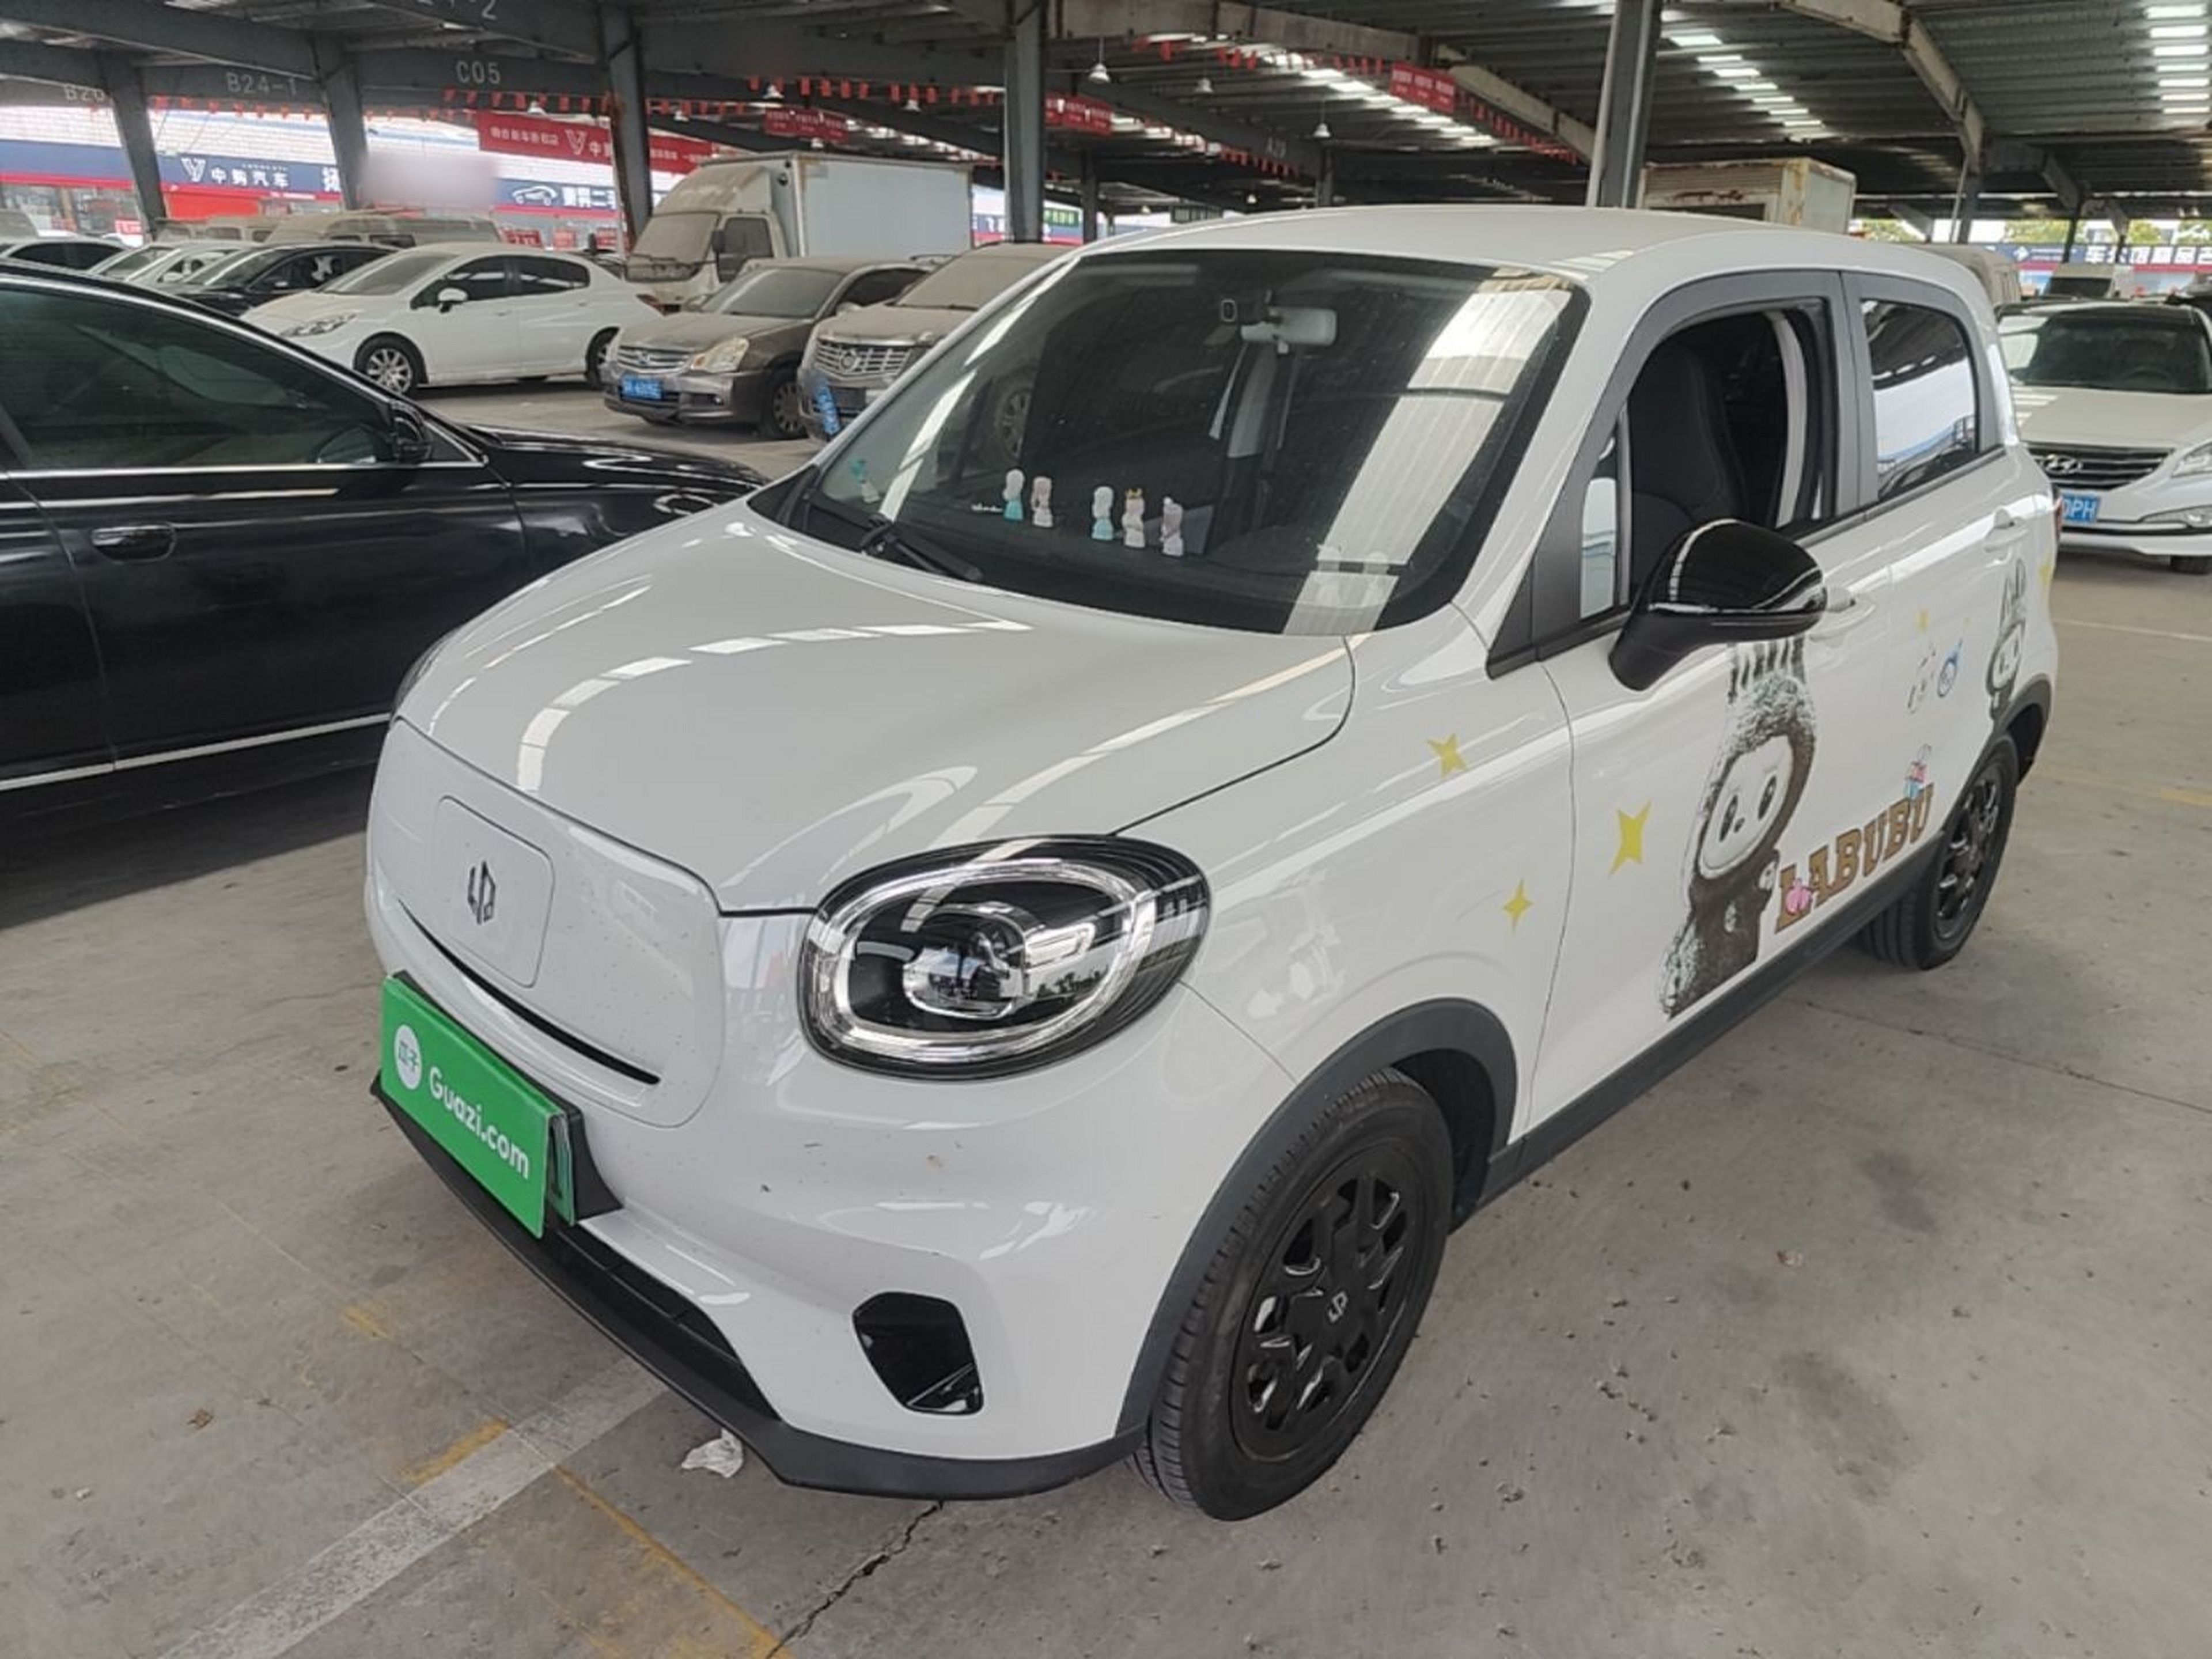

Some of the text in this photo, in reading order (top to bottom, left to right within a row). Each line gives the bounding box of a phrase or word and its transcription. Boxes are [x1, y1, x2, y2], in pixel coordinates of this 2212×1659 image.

[226, 72, 297, 96] B24-1
[456, 60, 501, 84] C05
[1775, 782, 1934, 934] LABUBU
[430, 1066, 529, 1179] Guazi.com
